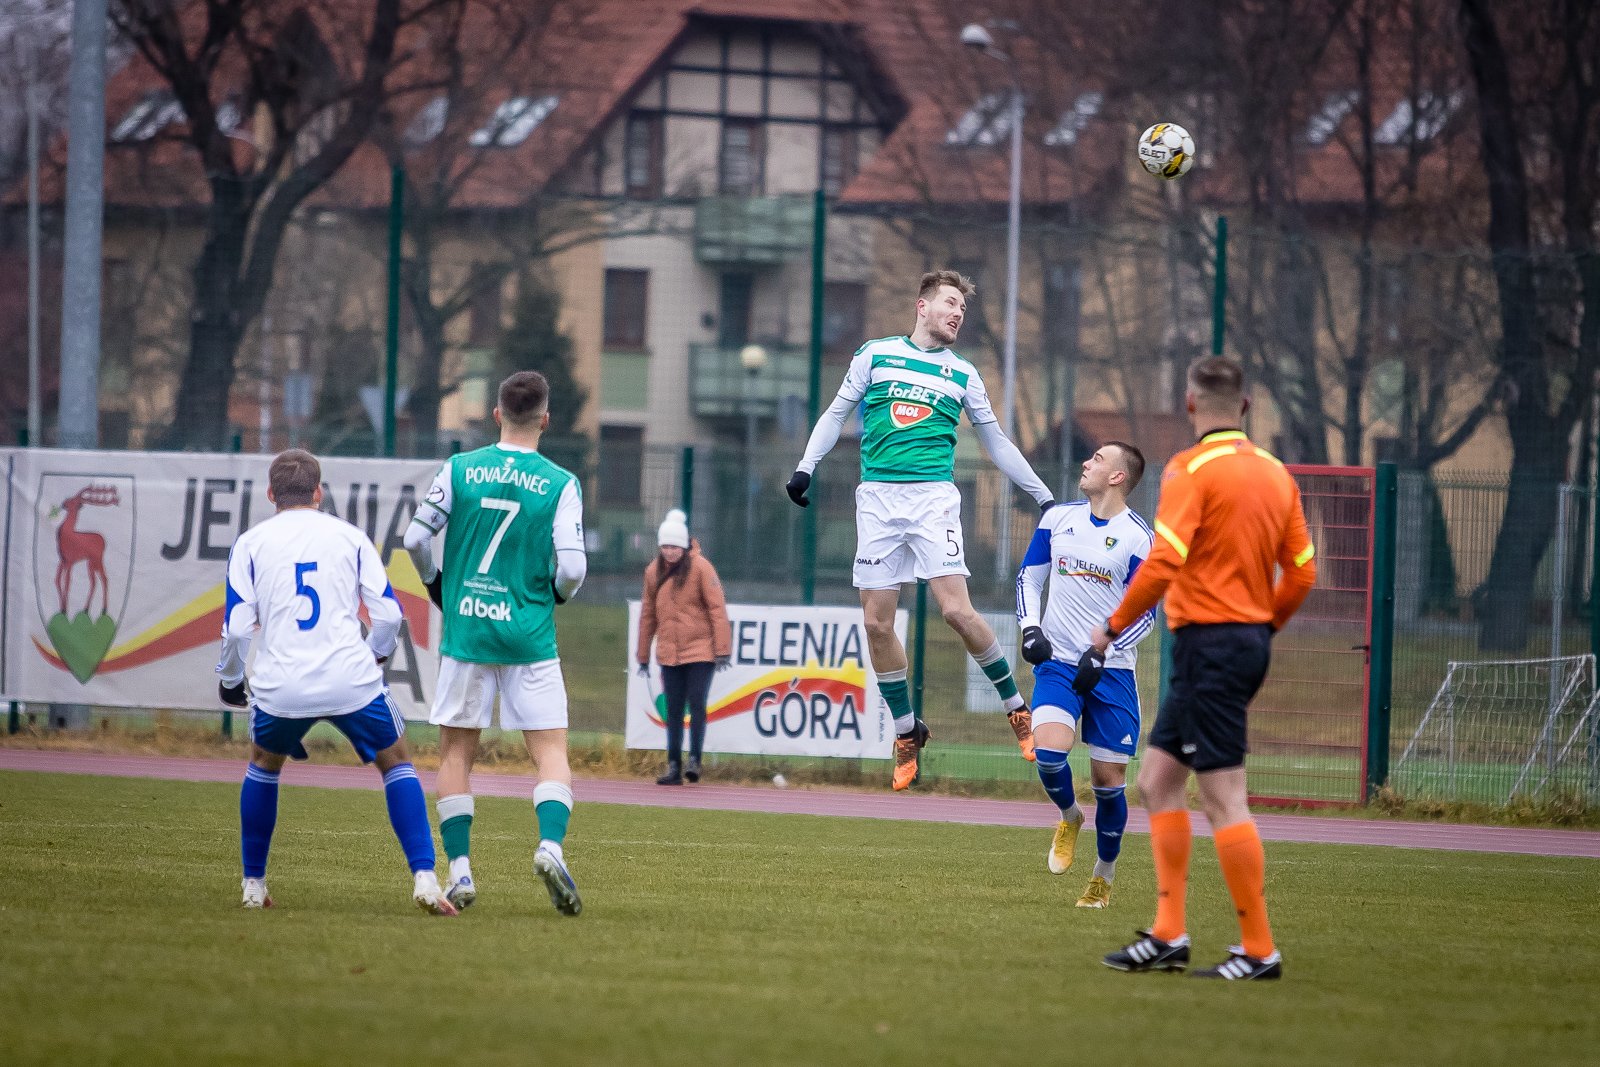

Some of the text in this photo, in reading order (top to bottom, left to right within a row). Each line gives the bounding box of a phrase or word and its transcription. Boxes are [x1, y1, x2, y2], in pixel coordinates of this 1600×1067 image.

[886, 381, 946, 406] forBET
[894, 404, 920, 418] MOL
[465, 462, 551, 496] POVAŽANEC
[480, 497, 521, 575] 7
[946, 529, 959, 557] 5
[856, 558, 873, 566] OMA
[1074, 559, 1112, 578] JELENIA
[294, 561, 321, 631] 5
[730, 619, 865, 669] ELENIA
[753, 676, 862, 741] GÓRA
